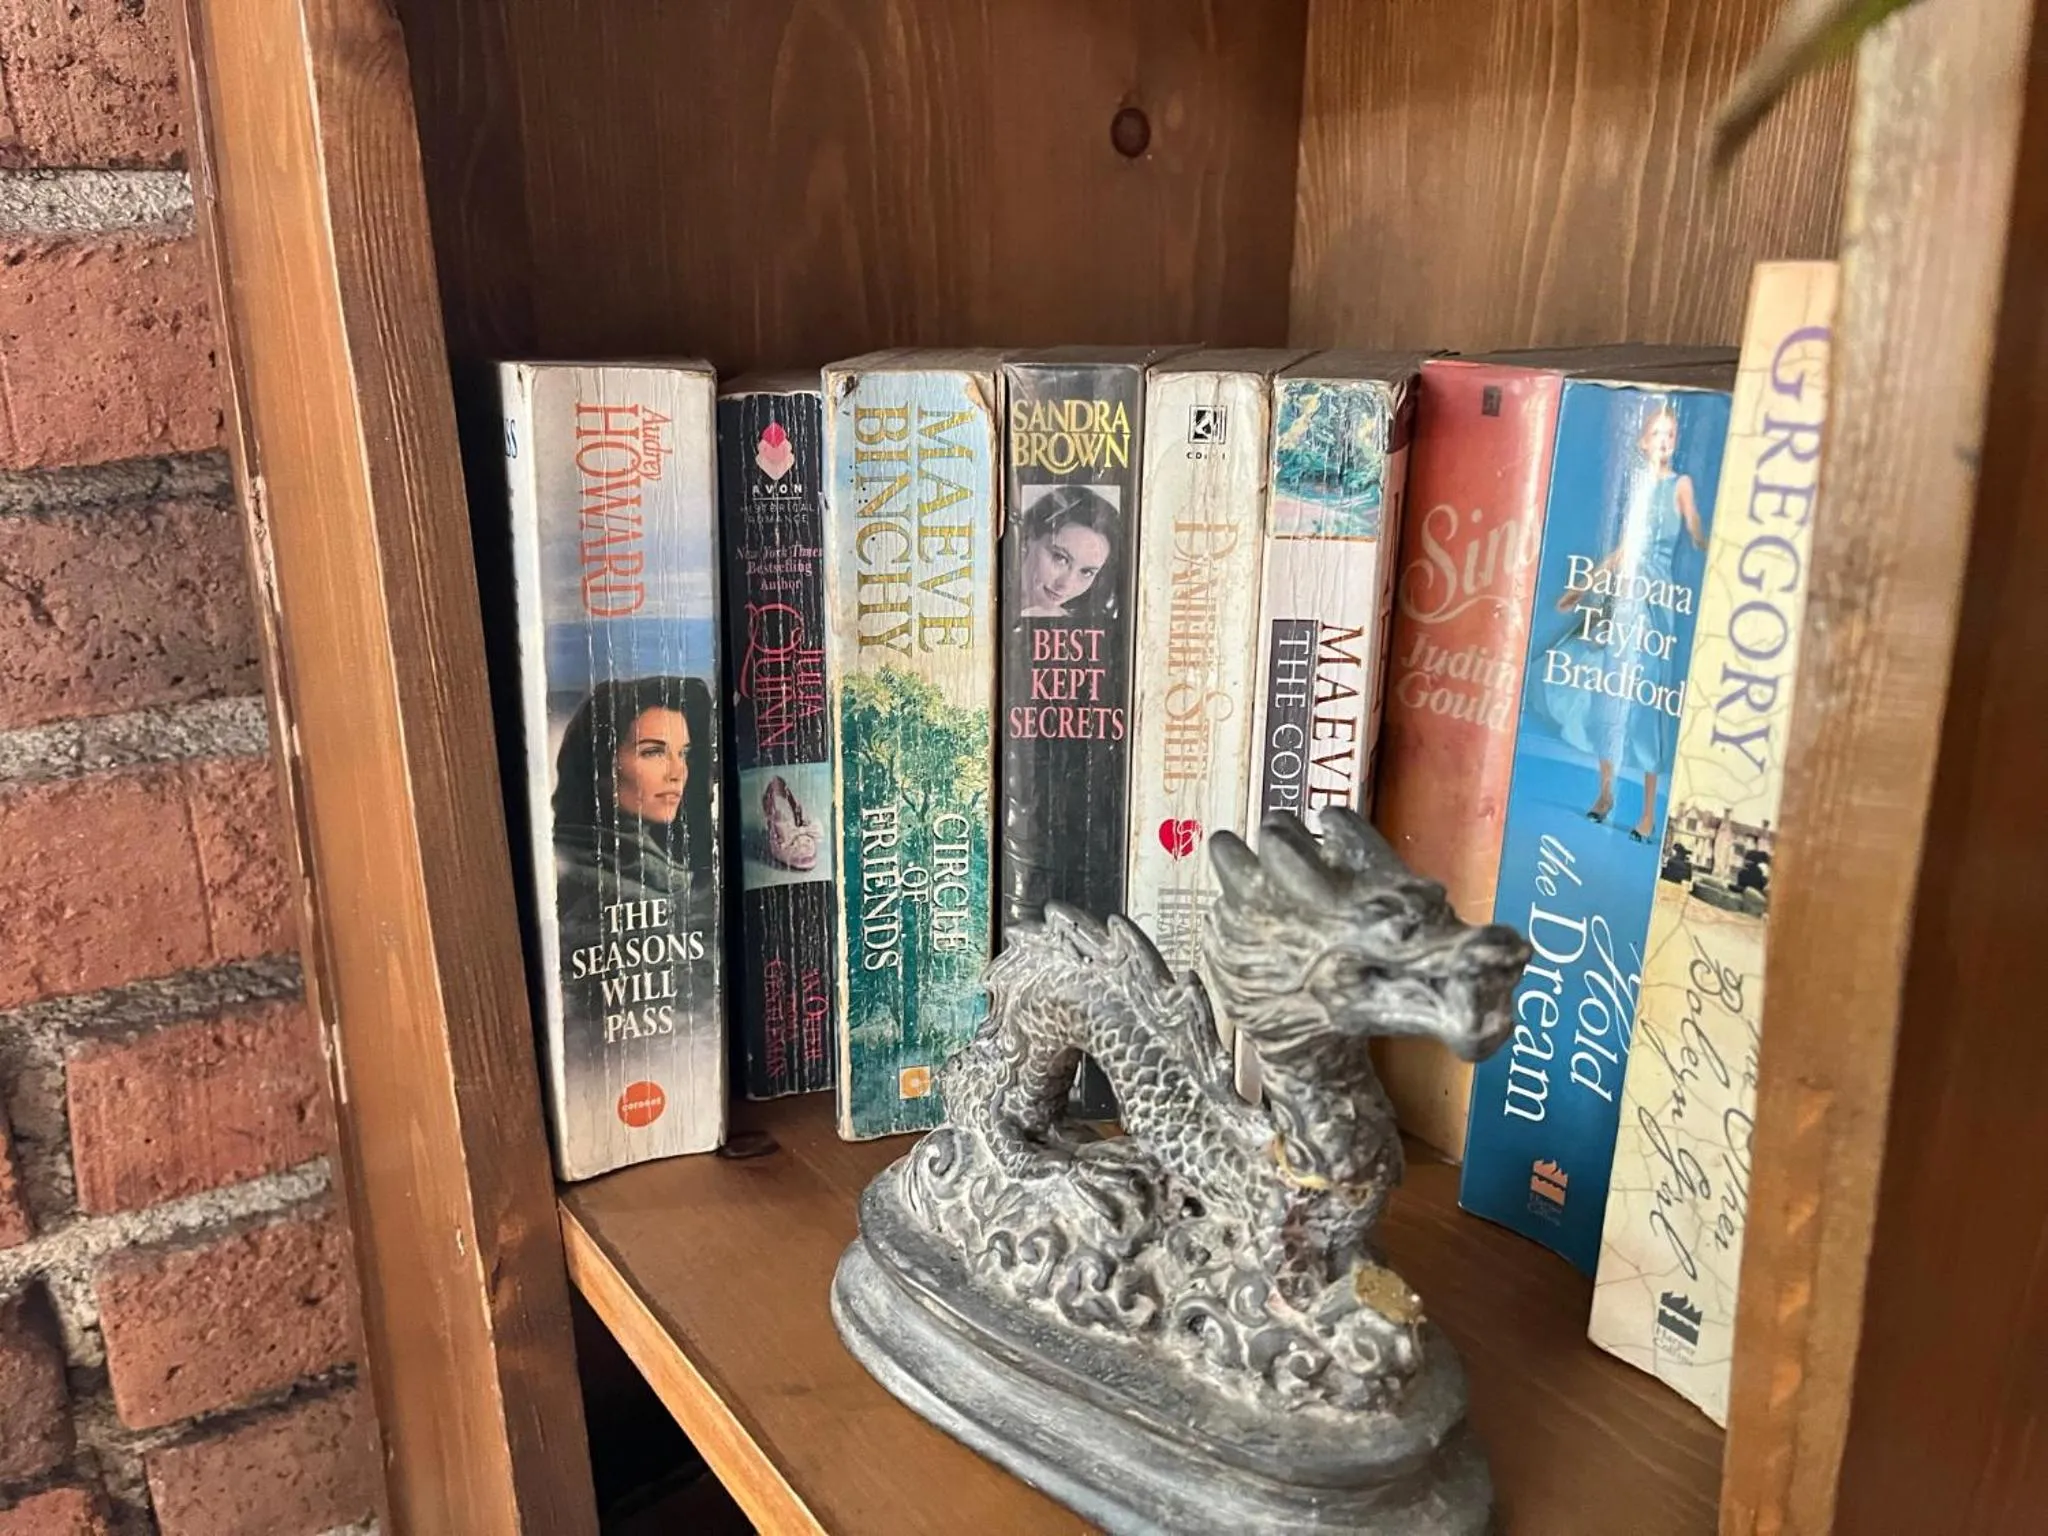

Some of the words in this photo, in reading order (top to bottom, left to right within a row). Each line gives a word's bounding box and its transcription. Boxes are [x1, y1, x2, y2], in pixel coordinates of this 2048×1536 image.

[640, 405, 673, 481] Audrey
[1012, 399, 1131, 434] SANDRA
[1011, 431, 1131, 475] BROWN
[576, 402, 645, 618] HOWARD
[752, 484, 802, 495] AVON
[854, 401, 913, 658] BINCHY
[917, 408, 976, 653] MAEVE
[1710, 325, 1832, 774] GREGORY
[1564, 554, 1693, 615] Barbara
[1033, 629, 1105, 662] BEST
[1574, 604, 1677, 661] Taylor
[740, 601, 804, 747] QUINN
[1030, 668, 1106, 702] KEPT
[1275, 630, 1311, 708] THE
[1397, 671, 1514, 732] Gould
[1542, 650, 1687, 718] Bradford
[1009, 707, 1125, 740] SECRETS
[1308, 621, 1364, 811] MAEVE
[1268, 723, 1304, 817] COP
[862, 807, 900, 972] FRIENDS
[901, 866, 928, 904] OF
[932, 812, 972, 951] CIRCLE
[1536, 833, 1582, 898] the
[605, 898, 669, 934] THE
[572, 931, 704, 980] SEASONS
[601, 970, 678, 1007] WILL
[606, 1005, 674, 1043] PASS
[1504, 901, 1588, 1122] Dream
[1571, 915, 1642, 1102] Hold
[1641, 934, 1743, 1124] Boleyn
[1638, 1105, 1710, 1281] Girl
